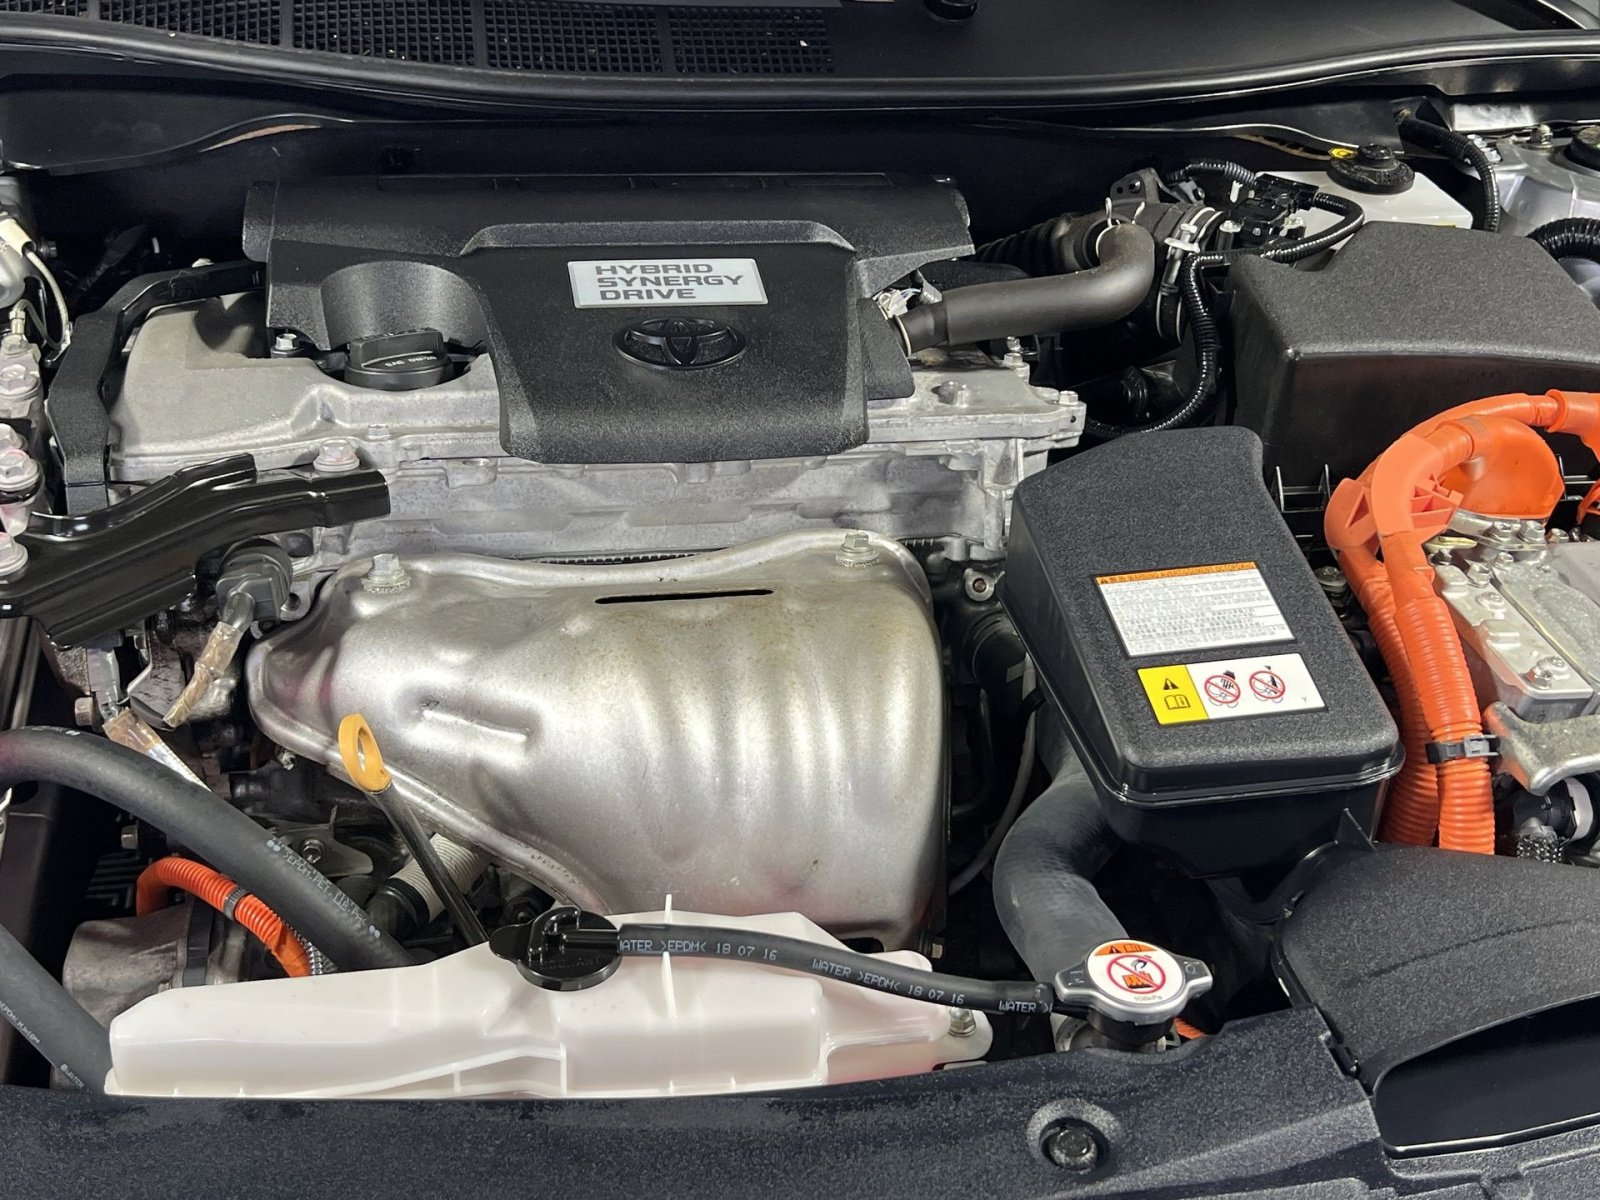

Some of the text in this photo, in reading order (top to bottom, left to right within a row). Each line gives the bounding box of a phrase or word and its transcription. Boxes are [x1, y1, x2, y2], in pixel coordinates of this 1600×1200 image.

[595, 264, 713, 275] HYBRID
[597, 275, 743, 288] SYNERGY
[600, 288, 696, 301] DRIVE
[661, 940, 706, 952] >EPDM<
[716, 942, 731, 954] 18
[738, 945, 755, 957] 07
[763, 948, 778, 961] 16
[812, 958, 851, 978] WATER
[857, 970, 900, 992] >EPDM<
[908, 984, 923, 998] 18
[928, 989, 945, 1001] 07
[951, 993, 965, 1005] 16
[1000, 1000, 1036, 1013] WATER
